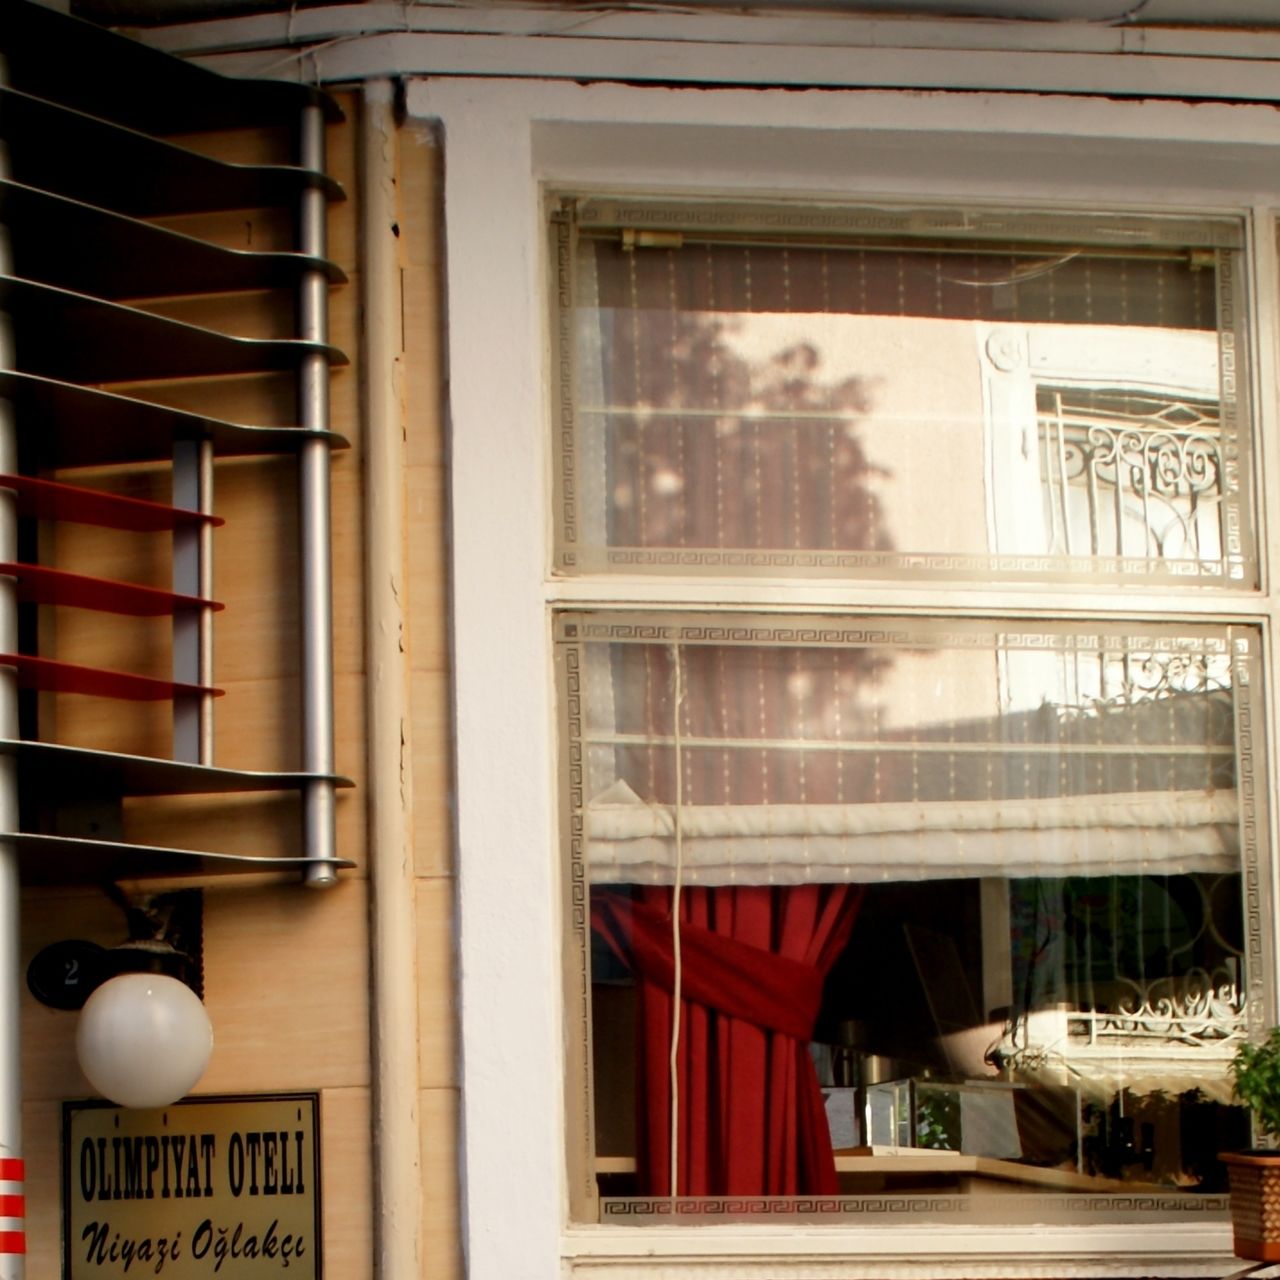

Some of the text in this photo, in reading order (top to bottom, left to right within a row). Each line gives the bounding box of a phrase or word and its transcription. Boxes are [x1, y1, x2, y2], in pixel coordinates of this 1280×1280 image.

[63, 957, 81, 986] 2
[79, 1107, 306, 1203] OLİMPİYAT OTELİ
[81, 1217, 306, 1275] Niyazi Oğlakçı
